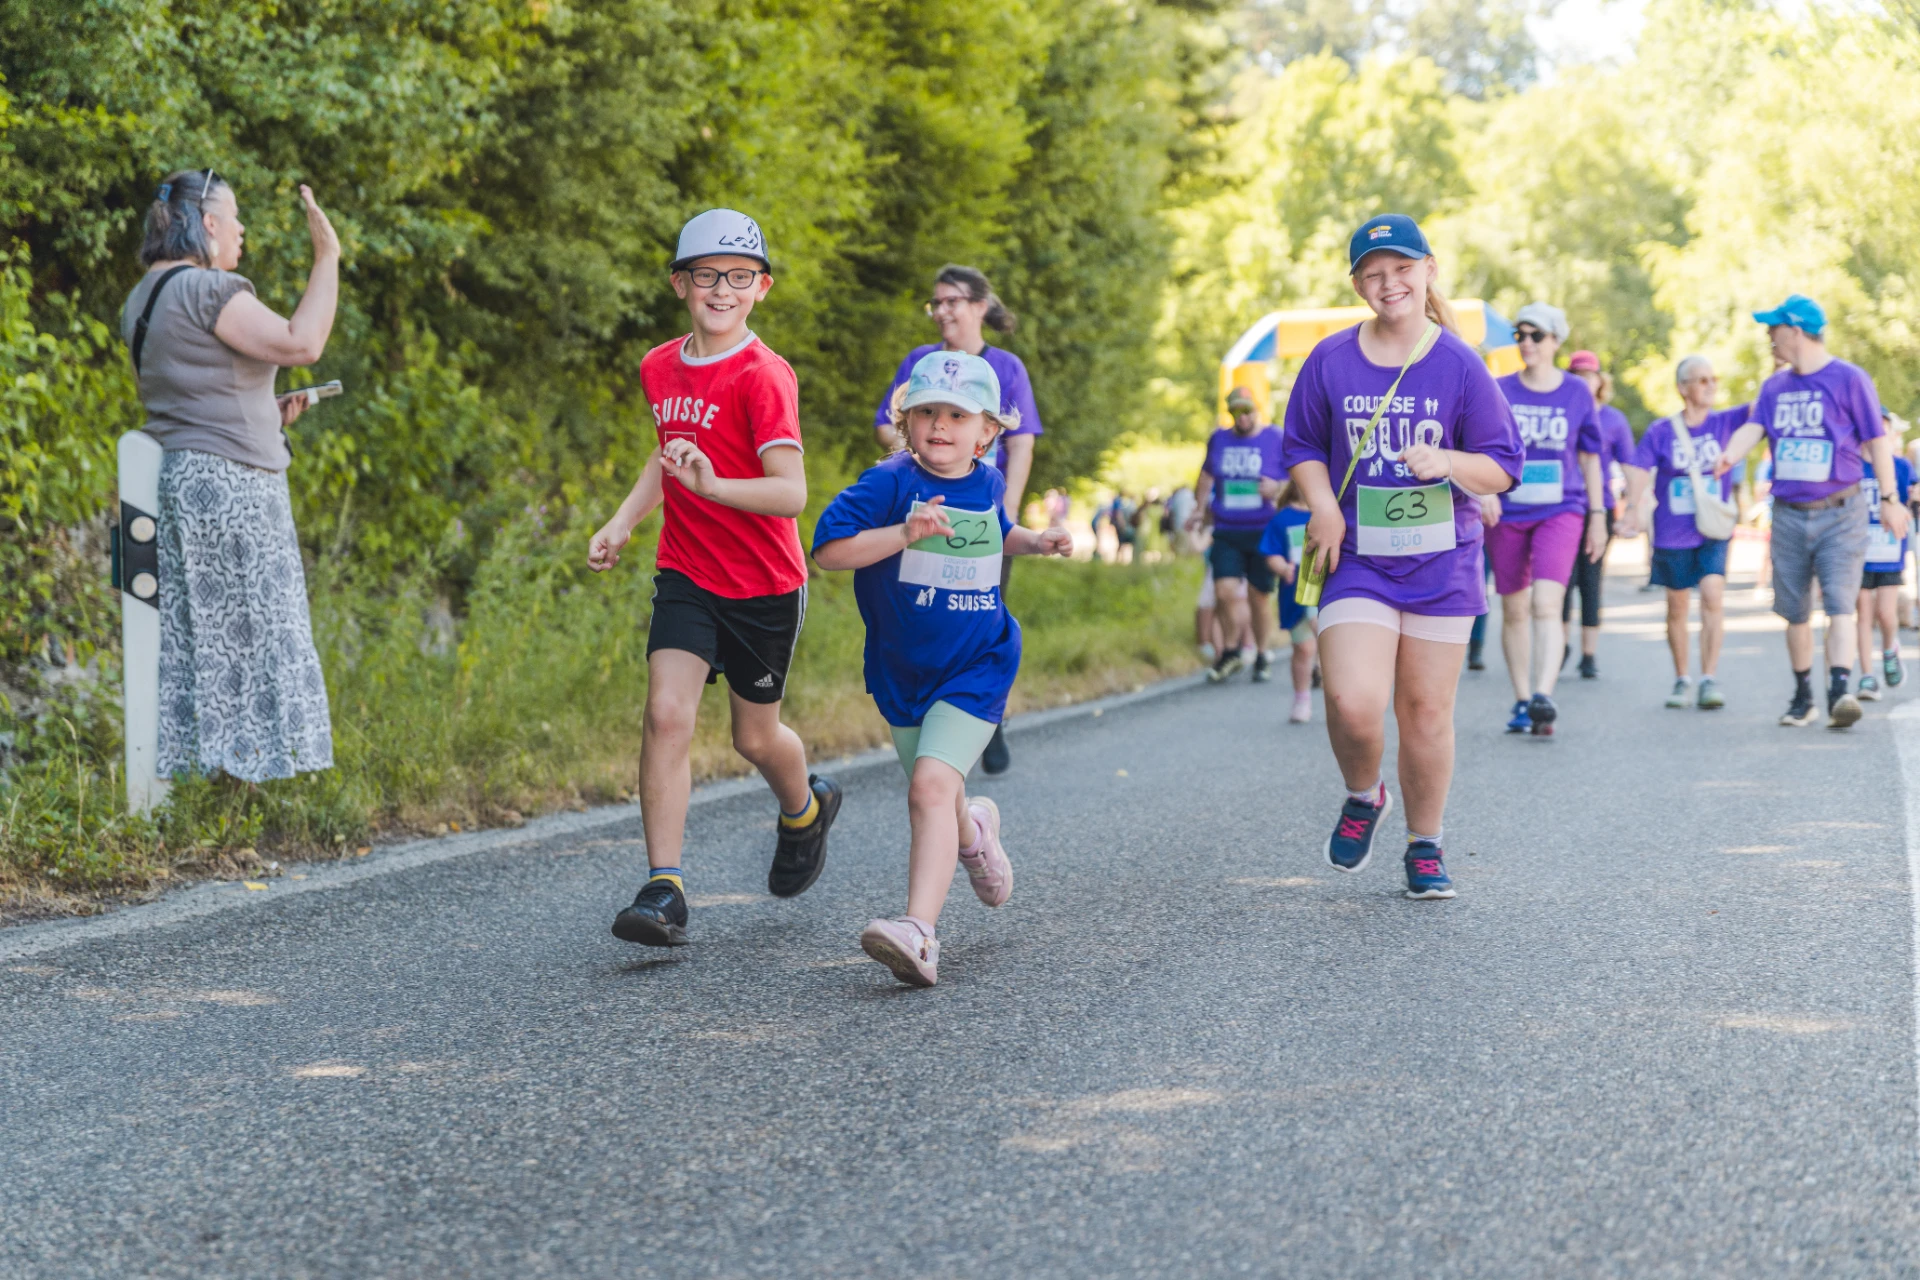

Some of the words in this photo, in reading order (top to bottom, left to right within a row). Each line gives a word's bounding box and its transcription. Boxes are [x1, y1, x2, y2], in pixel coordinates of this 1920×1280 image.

[653, 396, 720, 430] SUISSE
[1344, 395, 1415, 413] COUSE
[1773, 401, 1824, 429] DUO
[1782, 442, 1824, 462] 248
[1386, 491, 1428, 521] 63
[946, 519, 990, 549] 62
[1391, 533, 1422, 547] DUO
[942, 563, 977, 580] DUO
[947, 593, 997, 611] SUISSE
